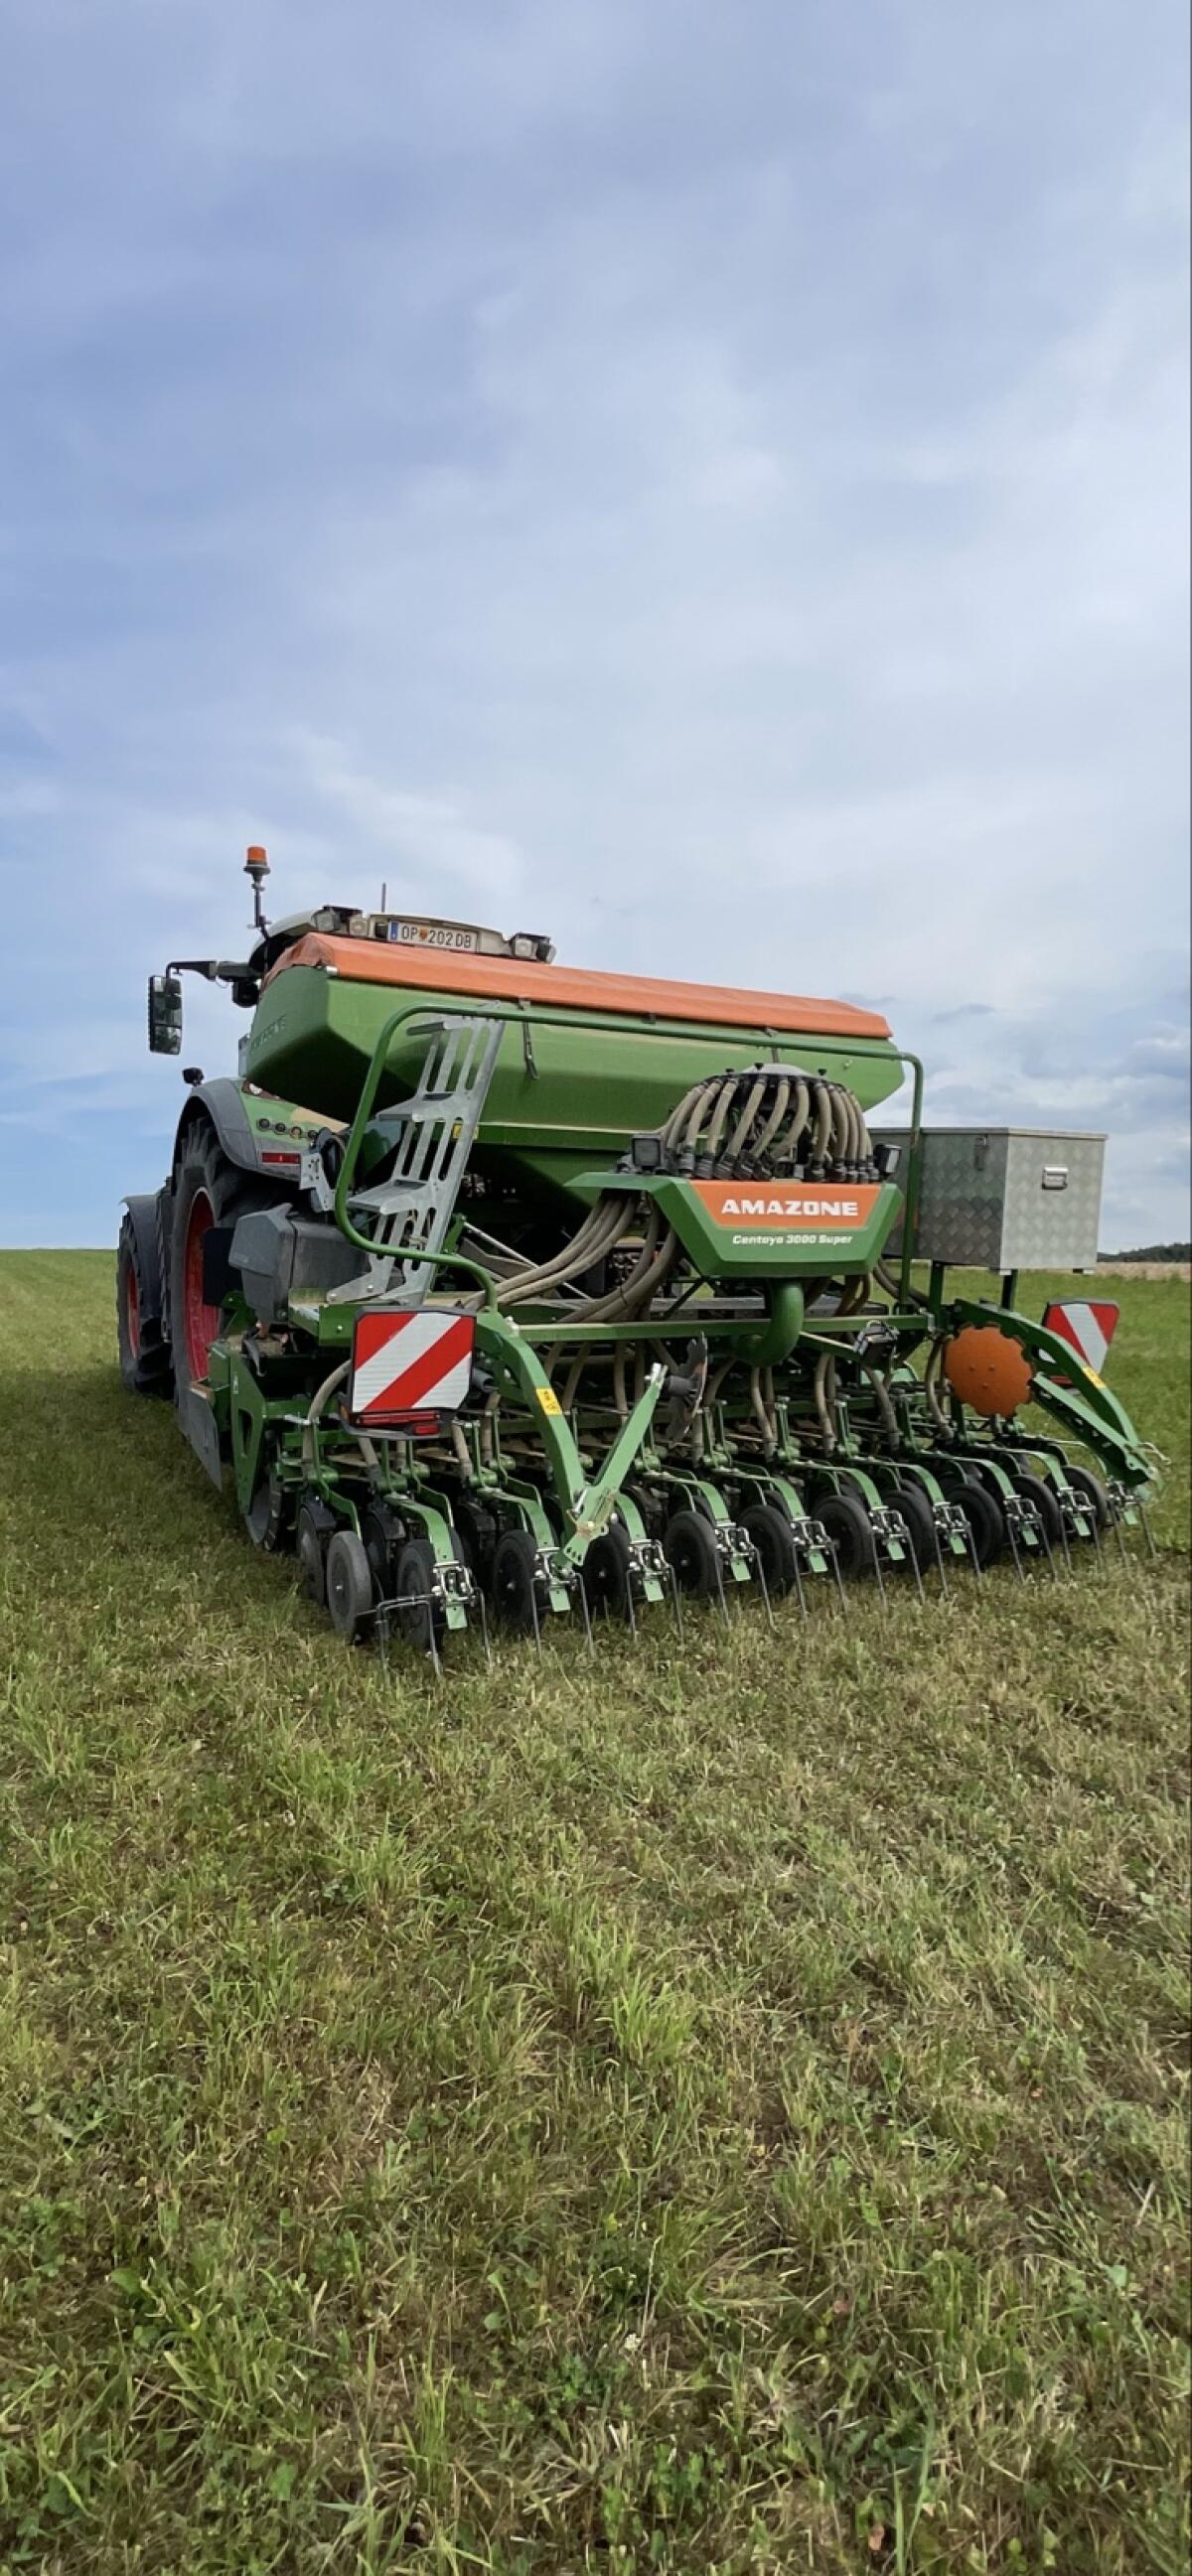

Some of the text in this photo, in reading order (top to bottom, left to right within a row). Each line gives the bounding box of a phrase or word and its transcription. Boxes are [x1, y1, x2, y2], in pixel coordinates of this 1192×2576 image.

[721, 1199, 859, 1216] AMAZONE
[732, 1234, 853, 1246] Centaya 3000 Super
